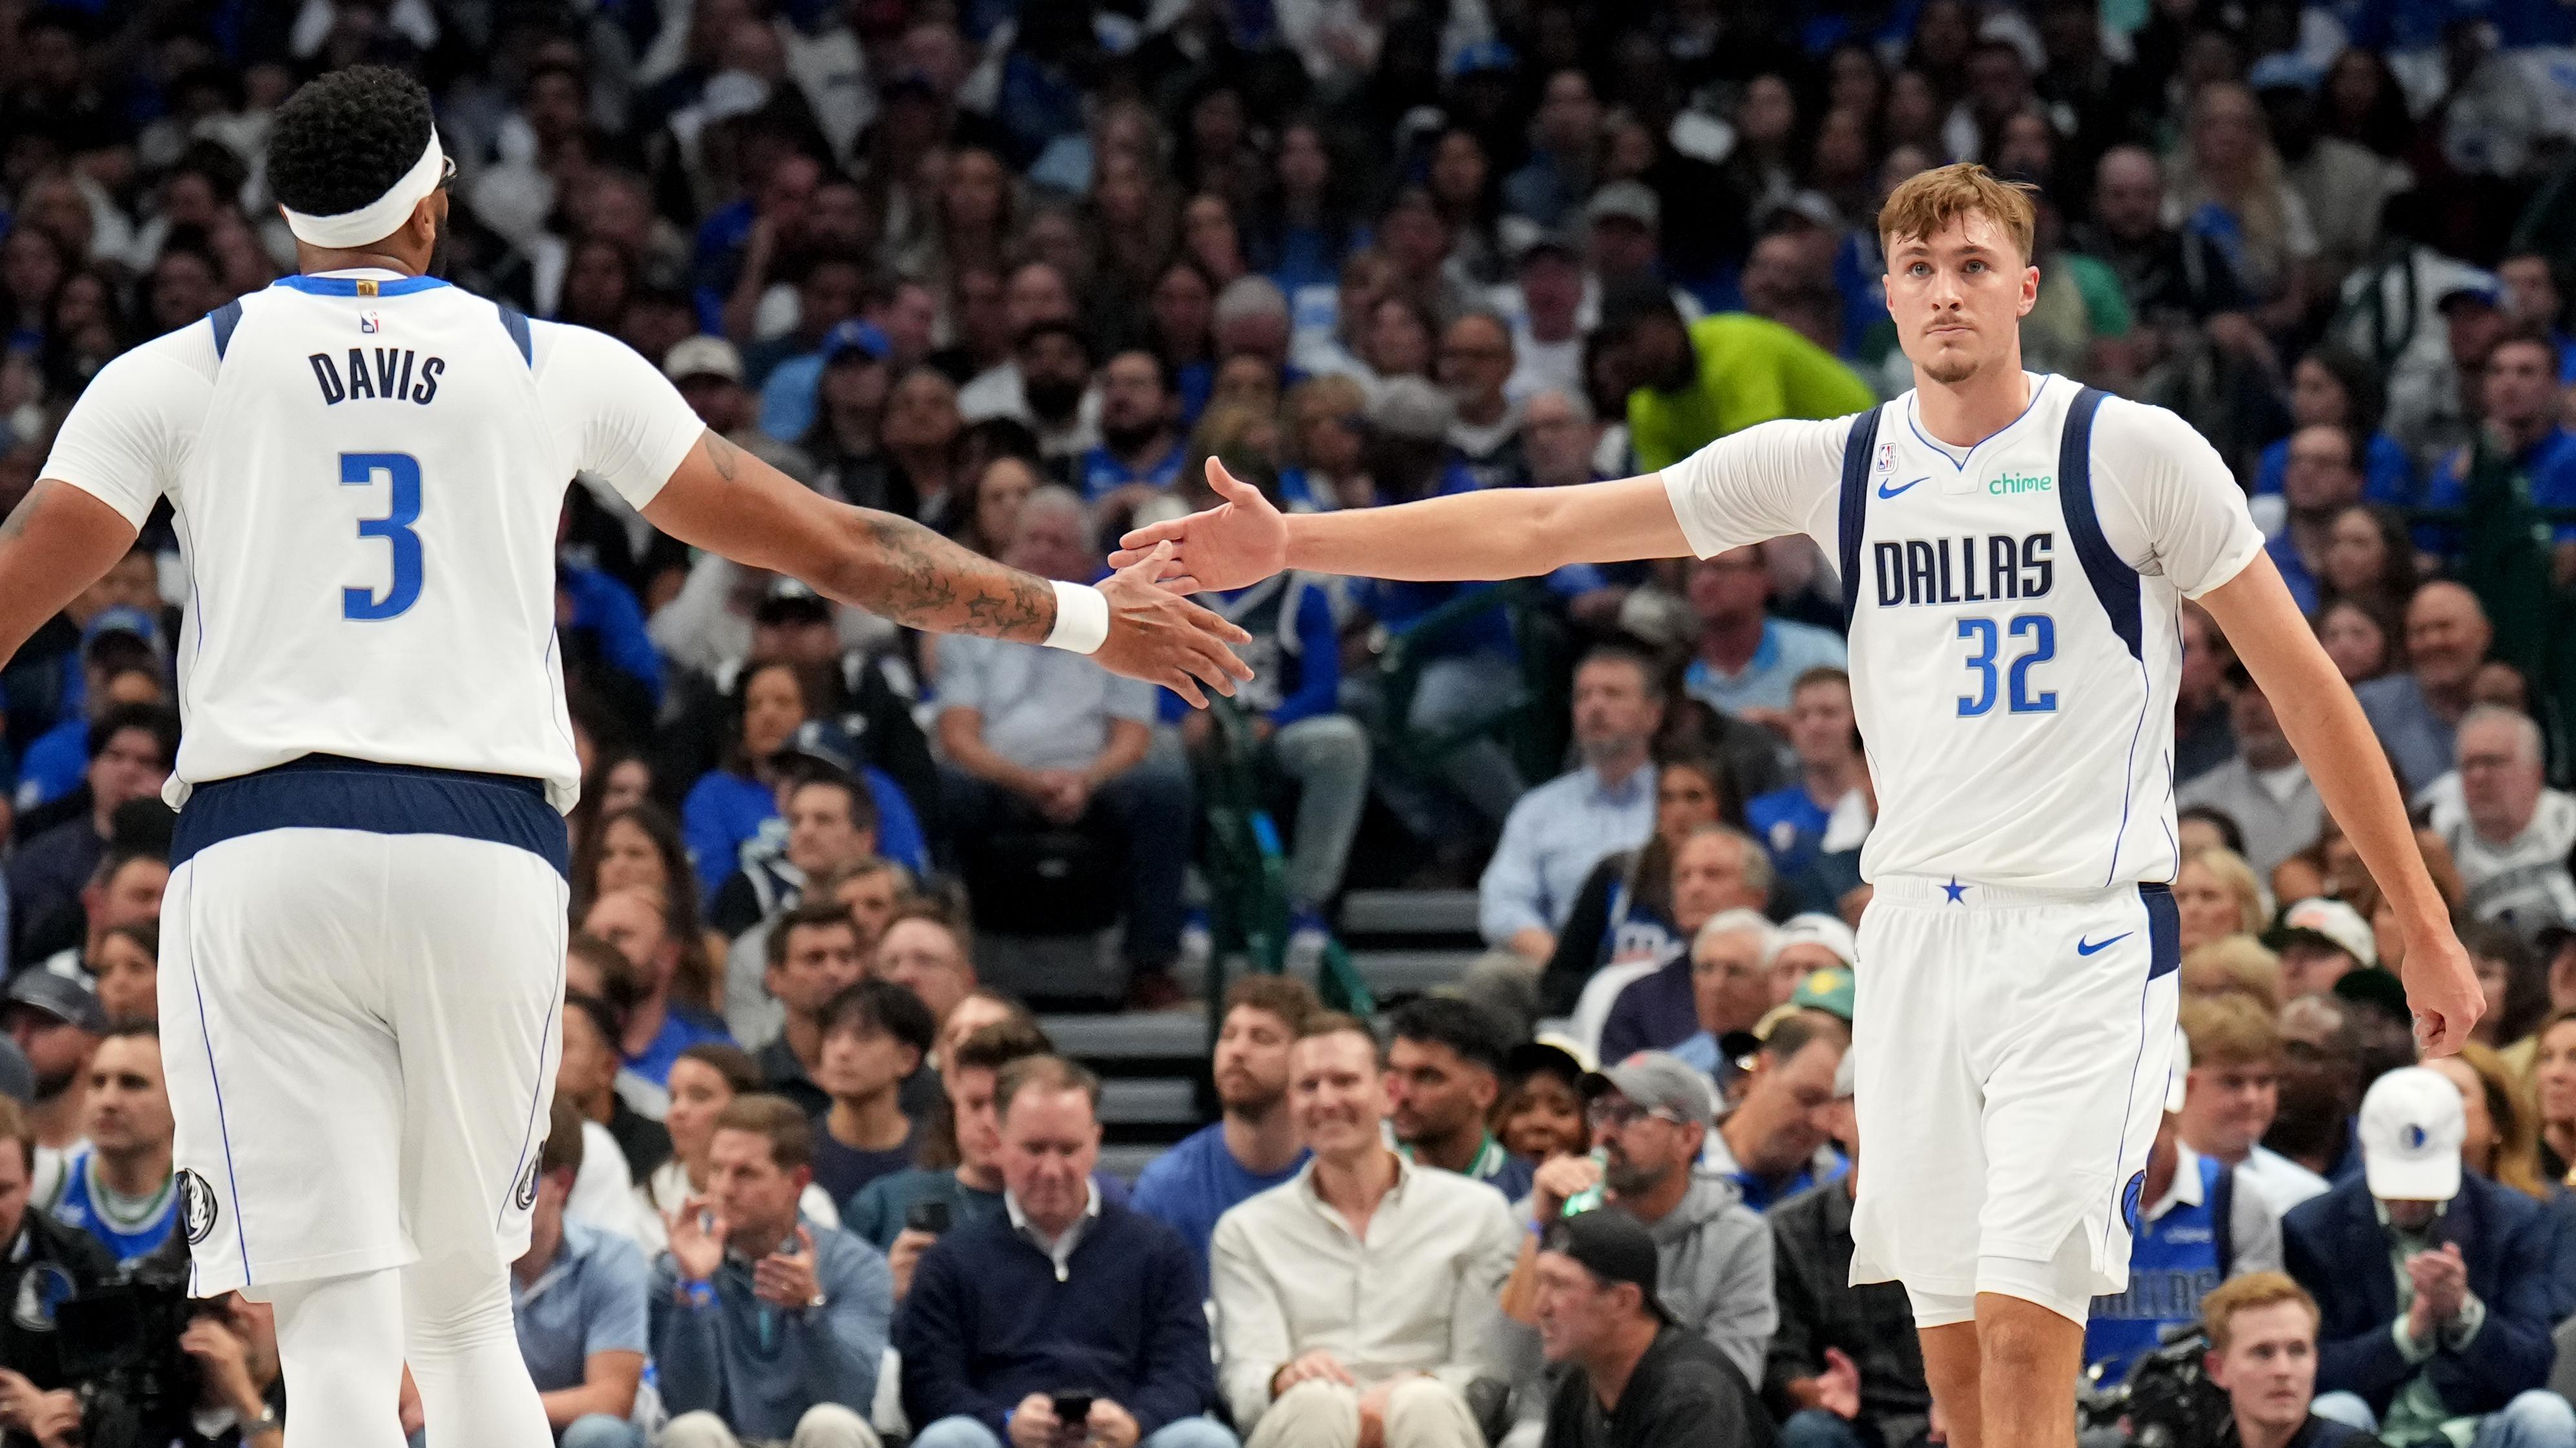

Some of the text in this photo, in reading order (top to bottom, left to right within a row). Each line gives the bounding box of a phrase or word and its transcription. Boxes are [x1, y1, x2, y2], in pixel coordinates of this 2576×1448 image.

[308, 348, 445, 406] DAVIS
[1989, 473, 2052, 495] chime
[338, 451, 425, 622] 3
[1873, 531, 2055, 609] DALLAS
[1956, 612, 2058, 719] 32
